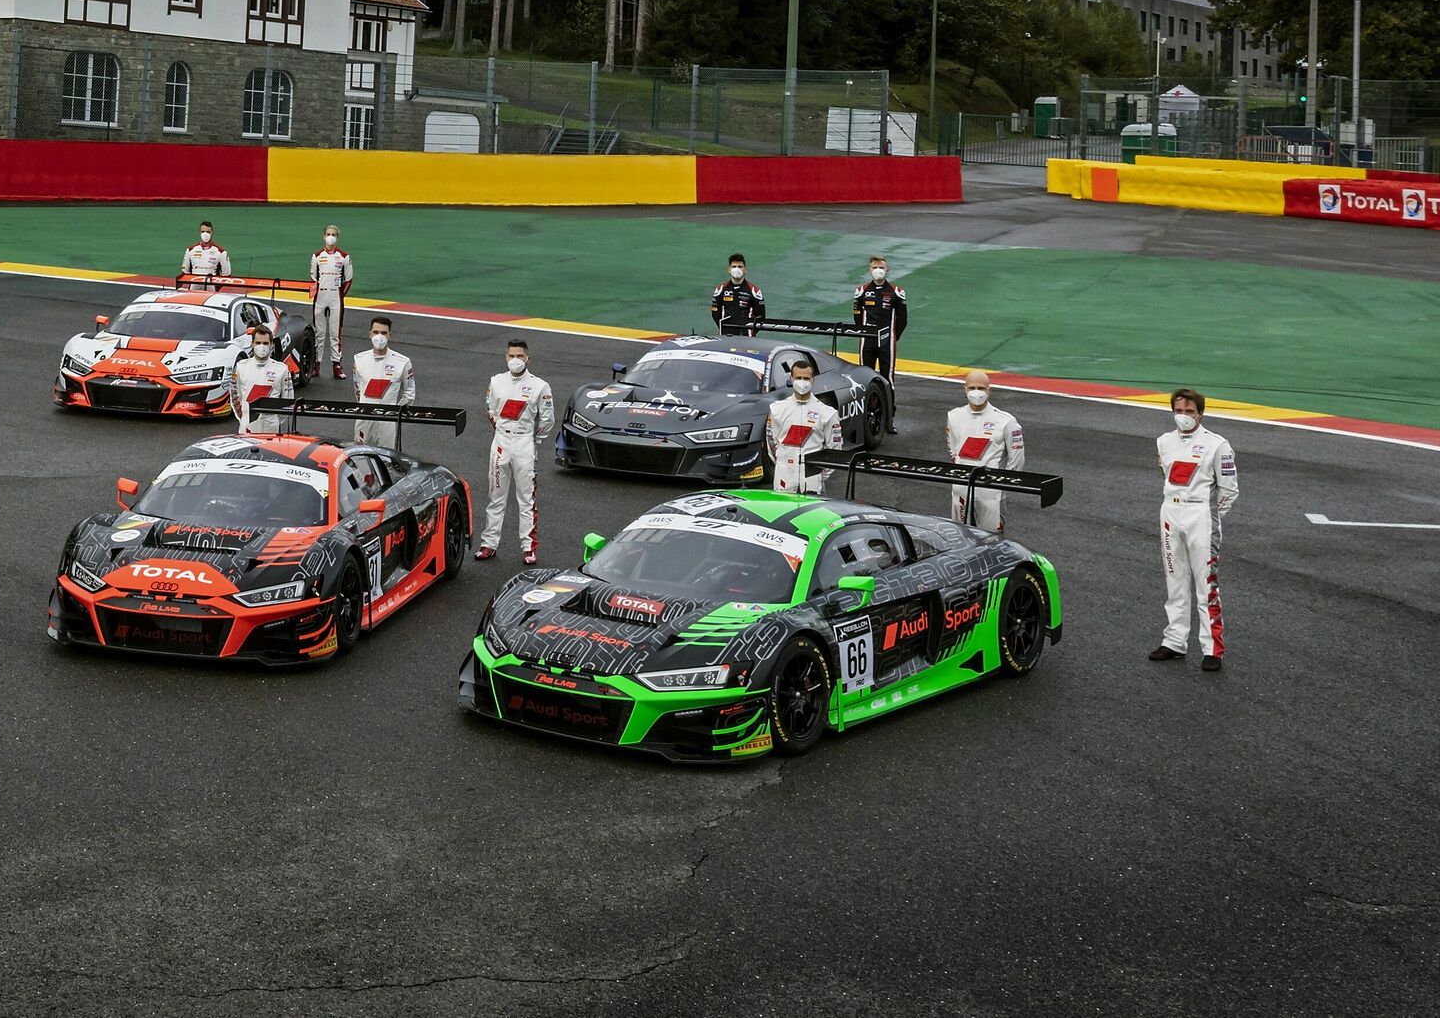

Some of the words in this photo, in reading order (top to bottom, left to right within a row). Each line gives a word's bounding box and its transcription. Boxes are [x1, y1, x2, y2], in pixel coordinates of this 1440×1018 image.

[1342, 191, 1400, 212] TOTAL
[110, 357, 156, 368] TOTAL
[585, 400, 710, 419] REBELLION
[183, 461, 206, 469] aws
[286, 468, 311, 479] aws
[648, 515, 674, 524] aws
[181, 525, 214, 534] Audi
[214, 527, 251, 540] Sport
[392, 526, 405, 546] Audi
[756, 531, 784, 543] aws
[1166, 552, 1174, 574] Sport
[130, 564, 213, 584] TOTAL
[616, 596, 657, 612] TOTAL
[900, 611, 928, 639] Audi
[945, 602, 981, 630] Sport
[131, 626, 165, 639] Audi
[171, 630, 211, 643] Sport
[554, 627, 589, 638] Audi
[589, 632, 632, 649] Sport
[847, 639, 867, 679] 66
[525, 700, 558, 716] Audi
[562, 707, 608, 726] Sport
